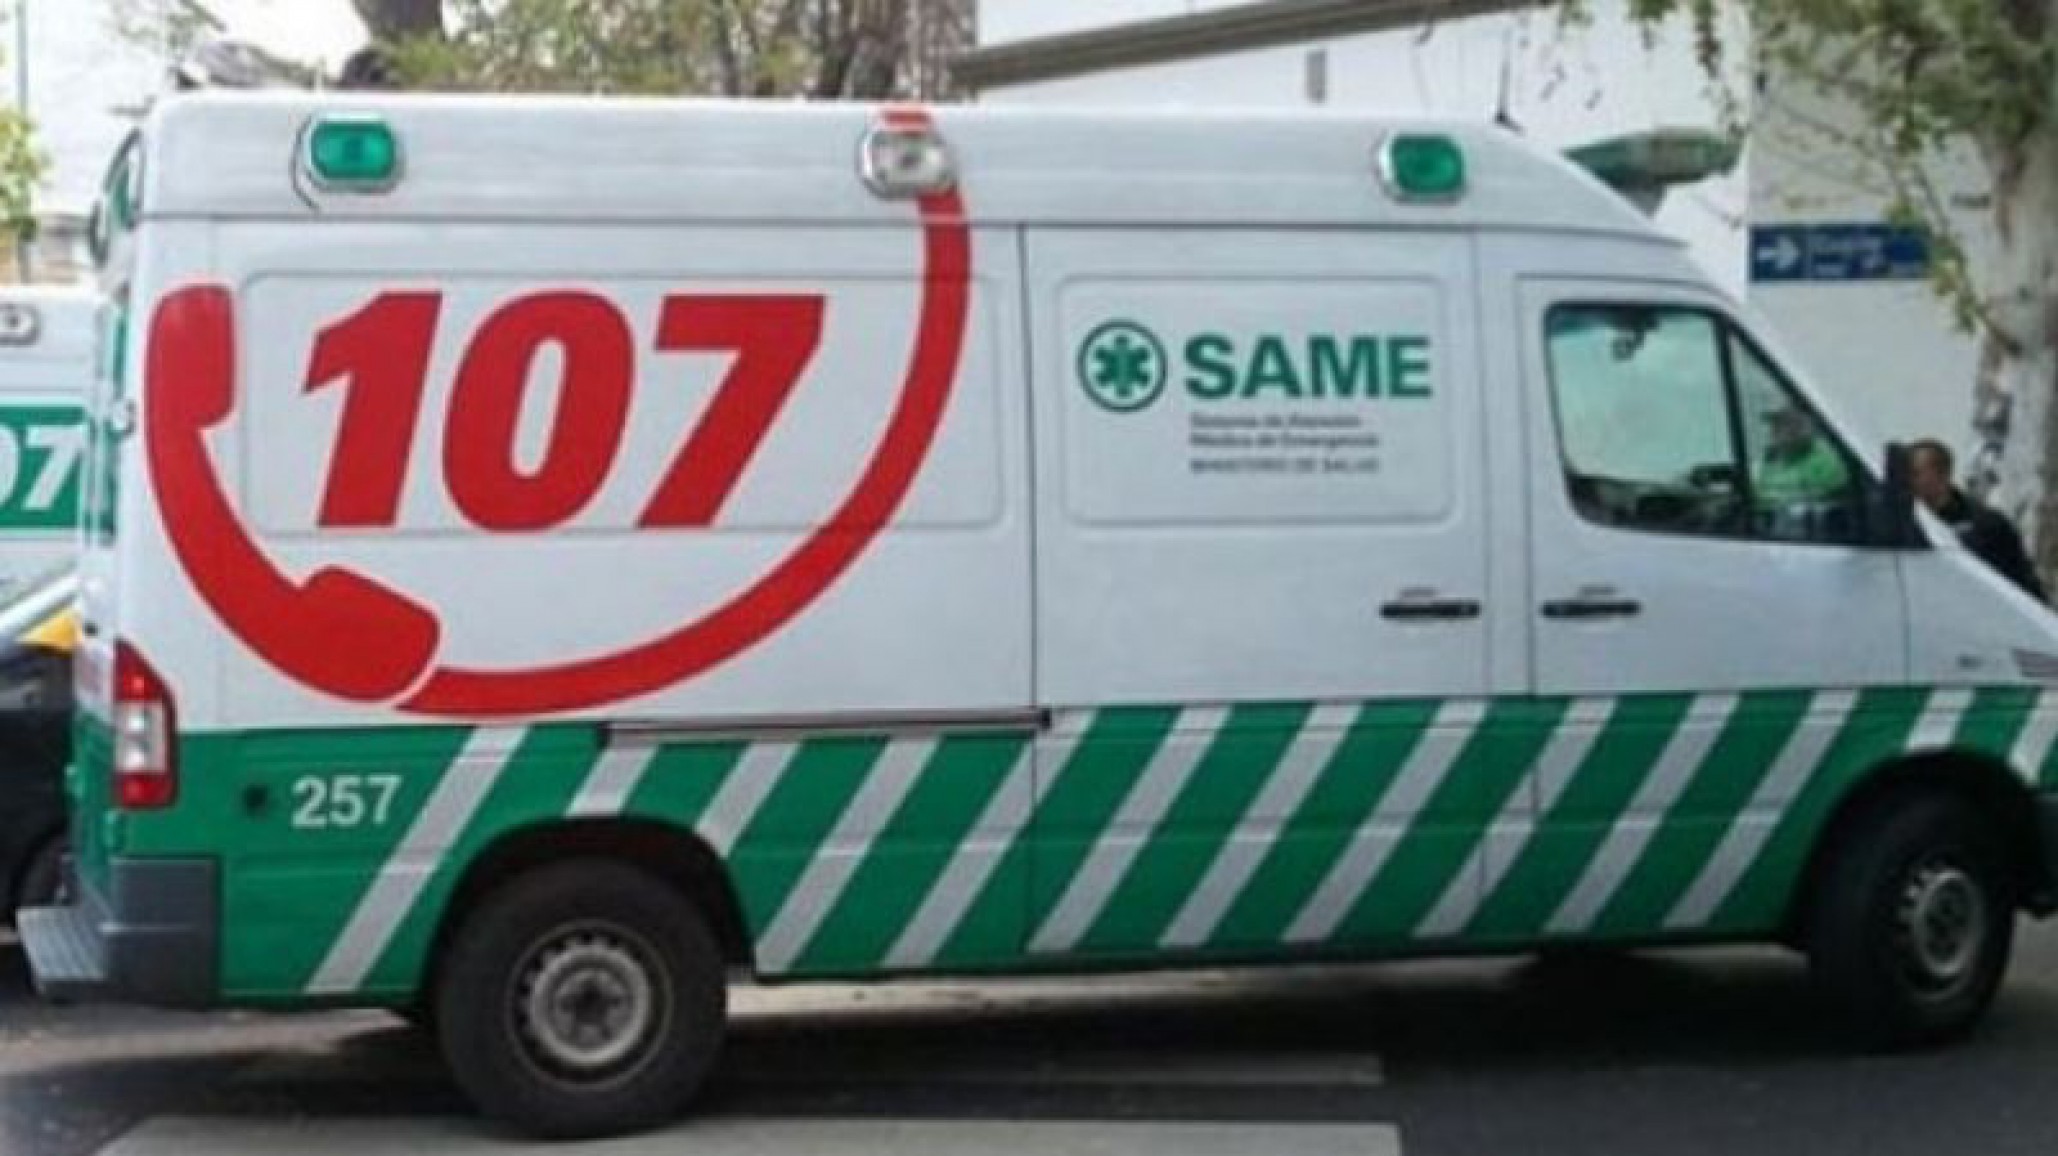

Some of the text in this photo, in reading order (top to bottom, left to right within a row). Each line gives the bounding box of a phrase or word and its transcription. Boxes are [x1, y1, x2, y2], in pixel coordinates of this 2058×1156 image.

[1183, 333, 1433, 400] SAME
[302, 290, 826, 532] 107
[291, 774, 402, 829] 257
